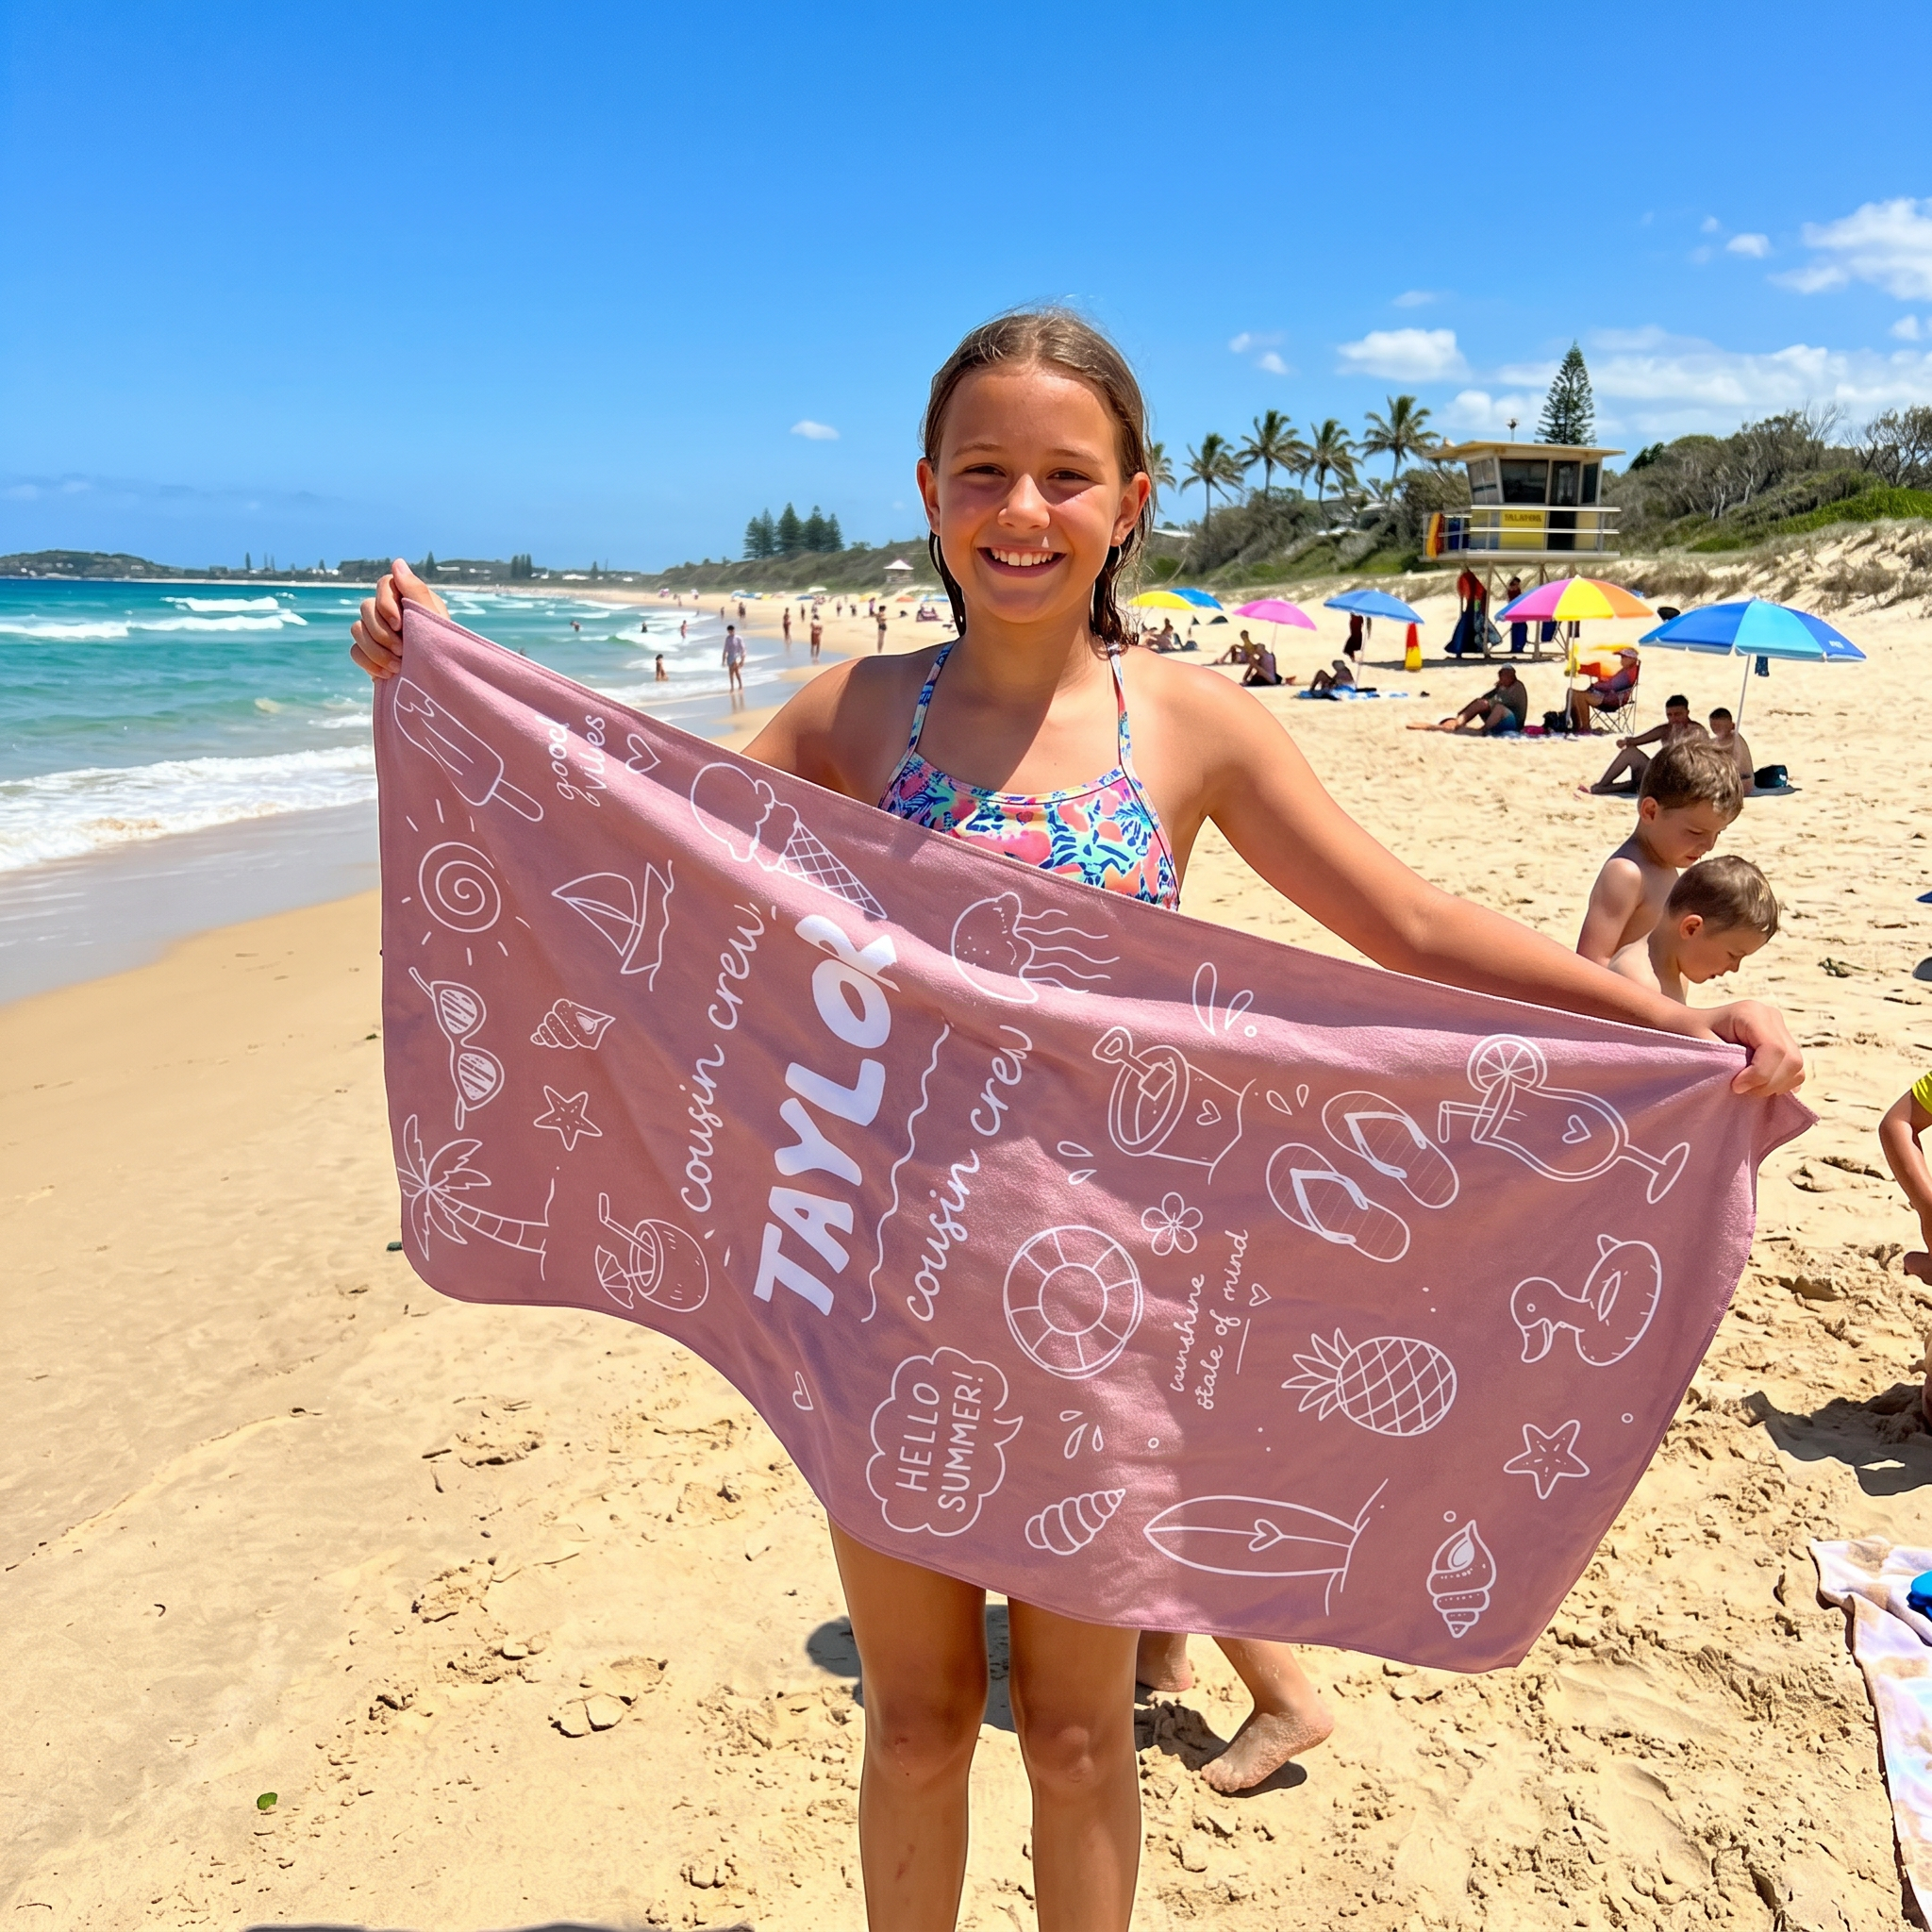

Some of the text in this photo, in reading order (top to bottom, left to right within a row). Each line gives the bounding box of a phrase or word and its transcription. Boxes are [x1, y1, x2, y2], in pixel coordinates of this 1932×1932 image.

[680, 903, 765, 1213] cousin crew
[753, 913, 902, 1317] TAYLOR
[907, 1148, 980, 1323] cousin
[1223, 1229, 1249, 1302] mind
[1209, 1308, 1241, 1337] of
[895, 1382, 941, 1492] HELLO
[938, 1371, 984, 1513] SUMMER!
